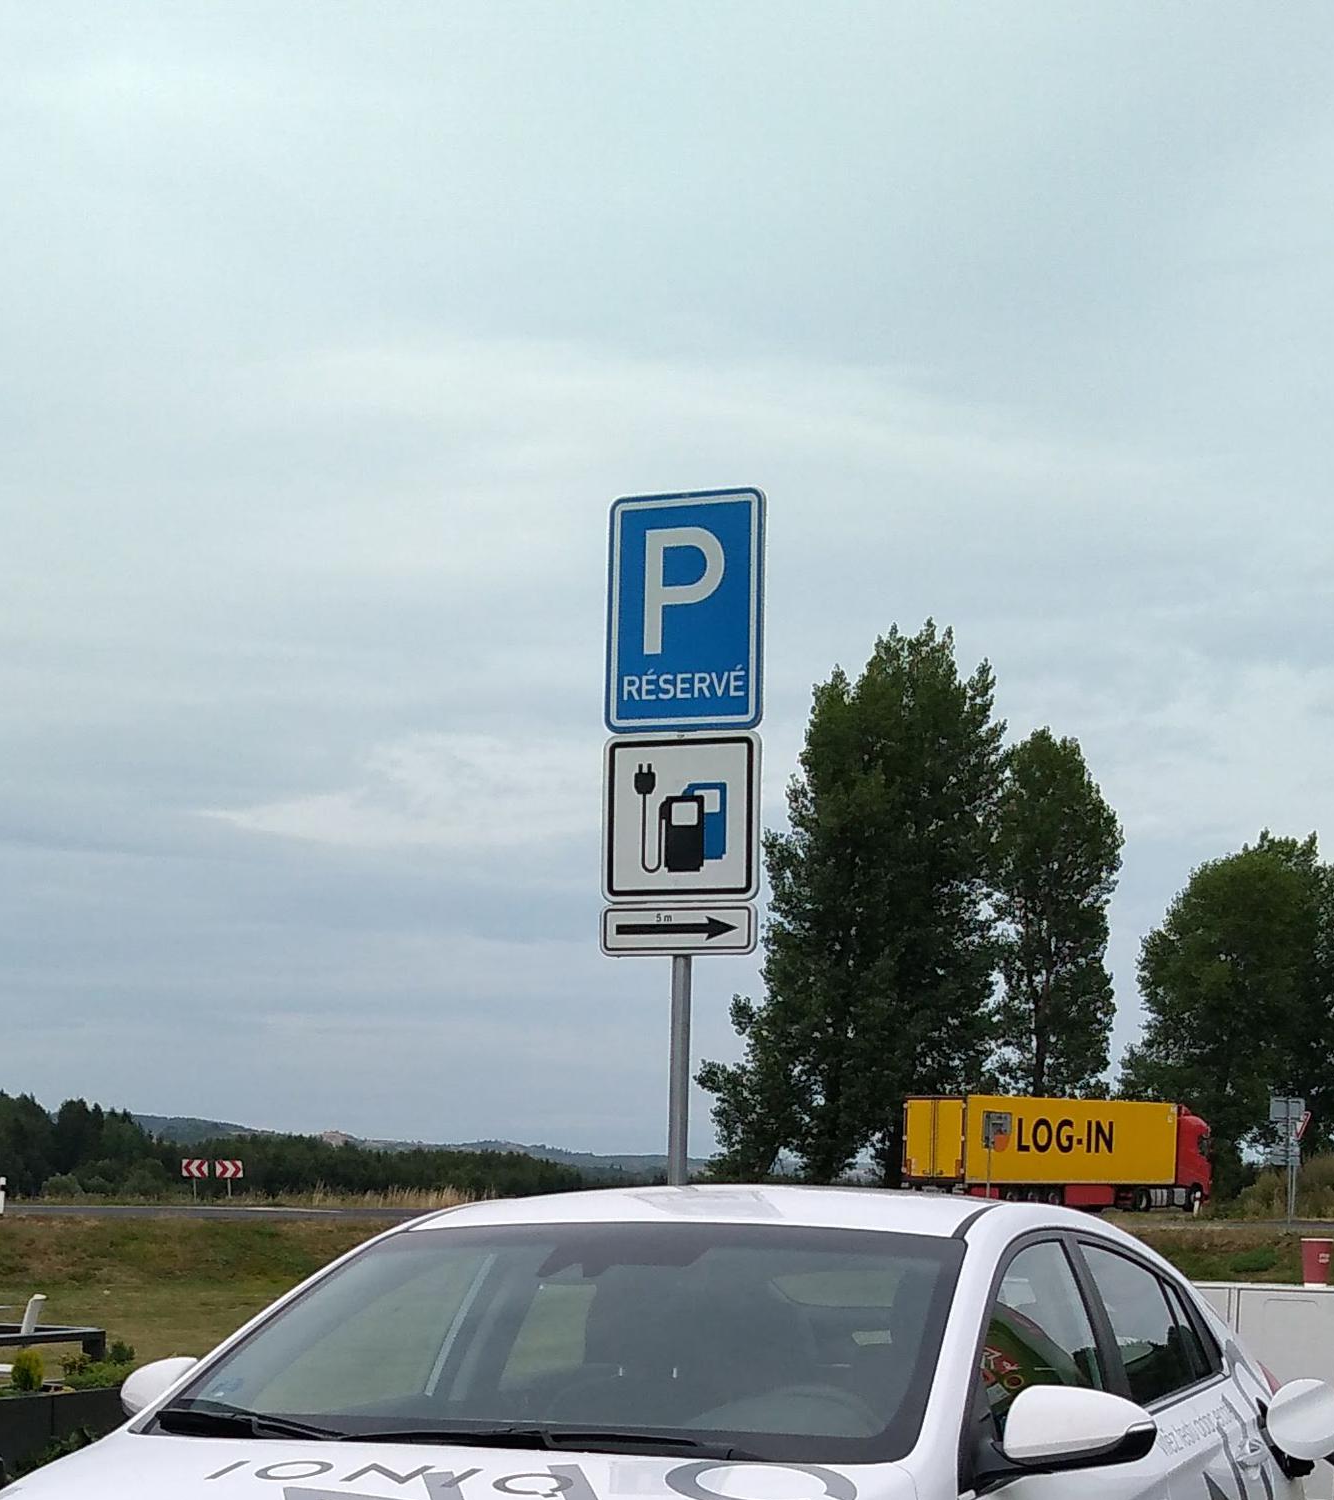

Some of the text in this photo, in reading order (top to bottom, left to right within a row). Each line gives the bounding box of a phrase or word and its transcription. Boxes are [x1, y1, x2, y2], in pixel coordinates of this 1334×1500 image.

[643, 526, 725, 655] P
[622, 664, 747, 701] RÉSERVÉ
[1017, 1117, 1115, 1154] LOG-IN
